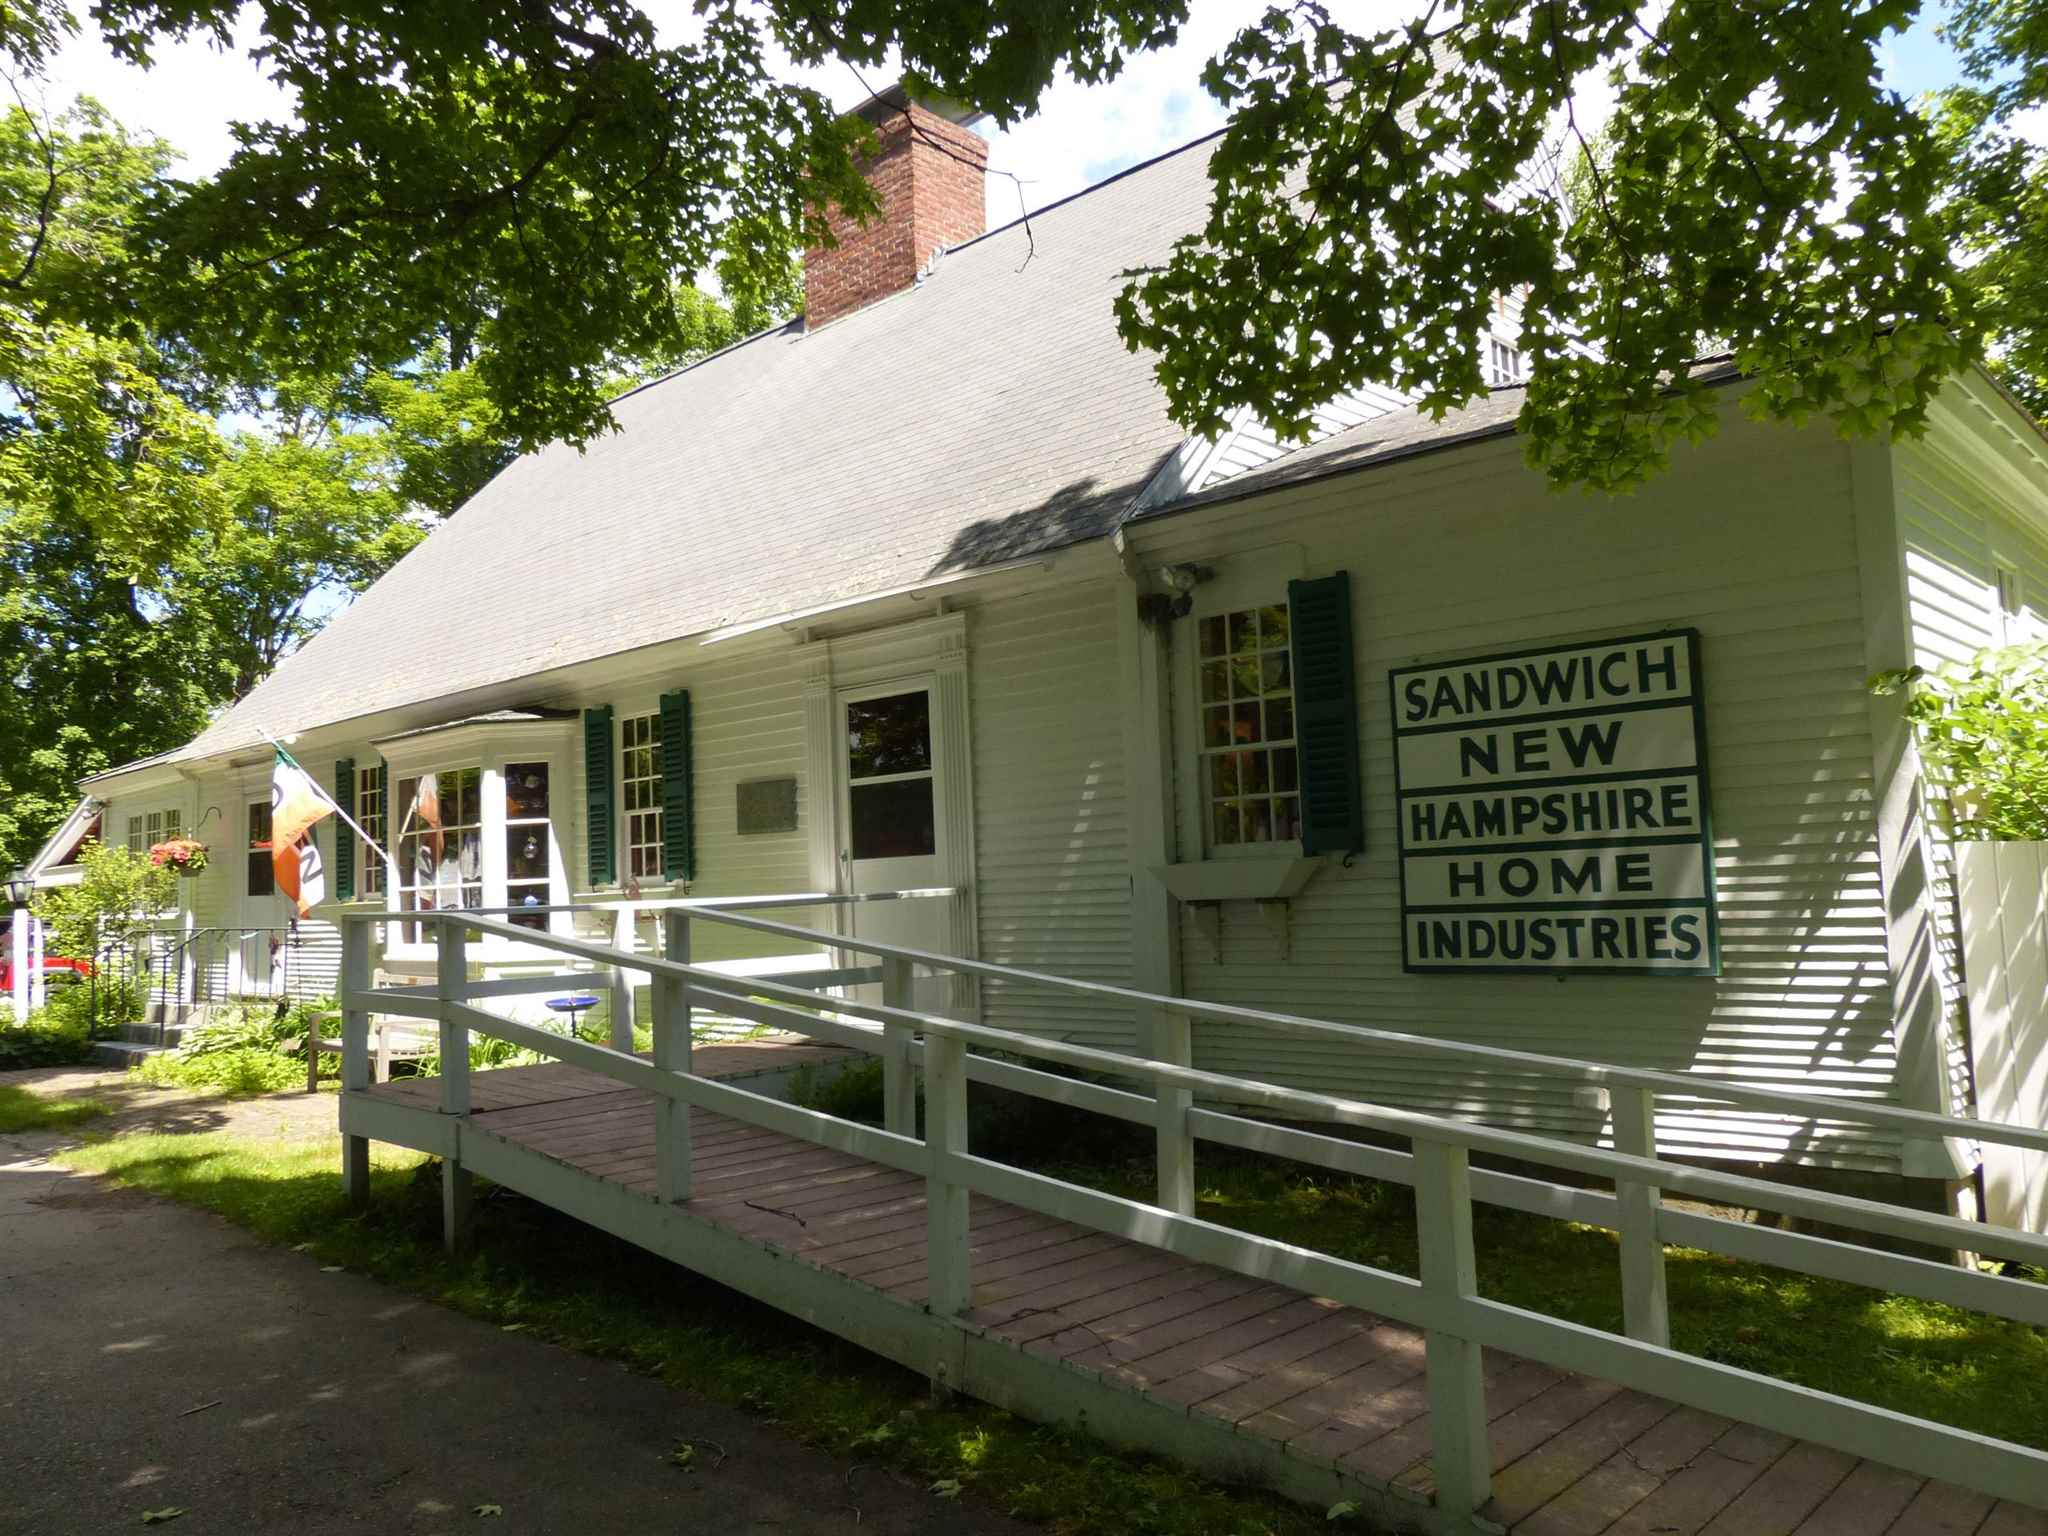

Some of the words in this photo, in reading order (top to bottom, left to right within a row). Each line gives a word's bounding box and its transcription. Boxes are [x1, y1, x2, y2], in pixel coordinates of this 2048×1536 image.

[1405, 646, 1677, 721] SANDWICH
[1459, 721, 1623, 777] NEW
[1411, 785, 1692, 841] HAMPSHIRE
[1448, 853, 1653, 897] HOME
[1417, 914, 1700, 960] INDUSTRIES
